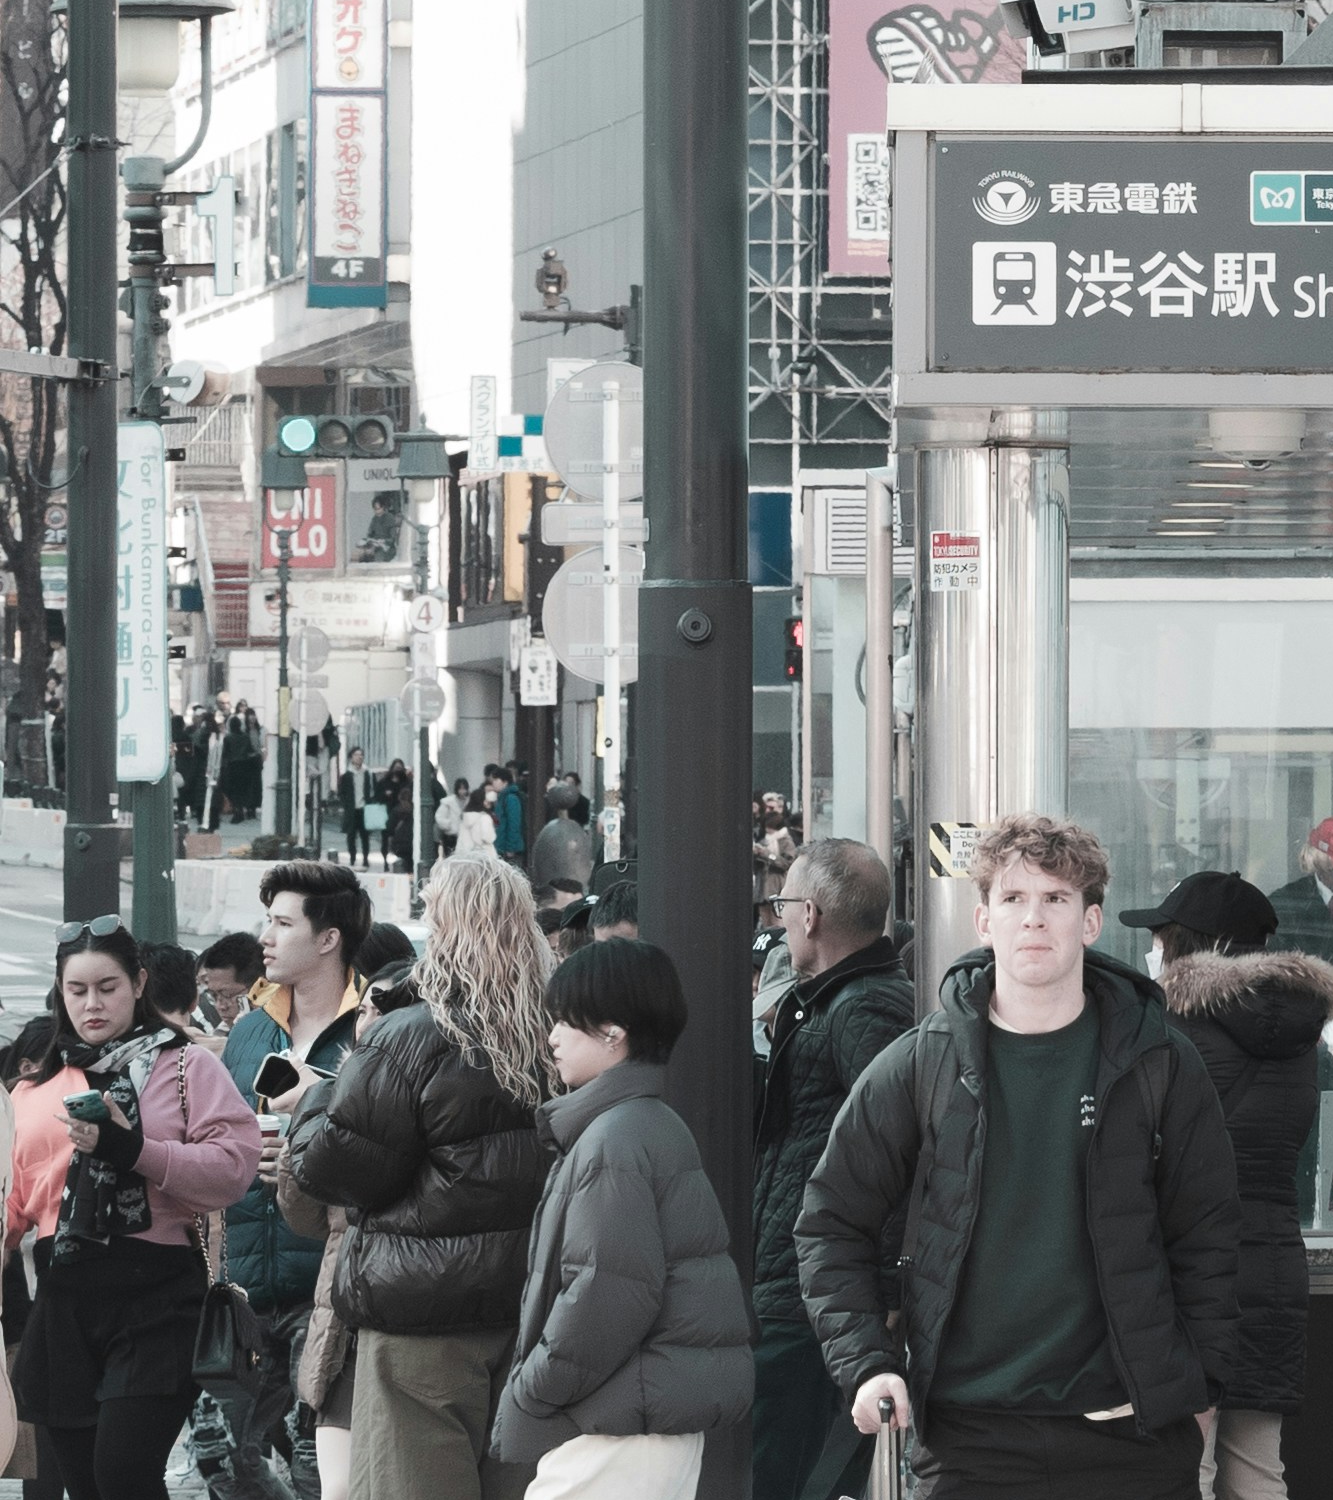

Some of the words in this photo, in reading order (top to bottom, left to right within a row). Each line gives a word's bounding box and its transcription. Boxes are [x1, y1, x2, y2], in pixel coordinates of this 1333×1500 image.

[335, 103, 364, 252] まねきねこ
[1048, 181, 1198, 215] 東急電鉄
[331, 259, 366, 279] 4F
[1065, 249, 1281, 320] 渋谷駅
[140, 454, 152, 484] for
[934, 562, 978, 574] 防犯カメラ
[140, 497, 159, 693] Bunkamura-dori
[417, 602, 434, 626] 4
